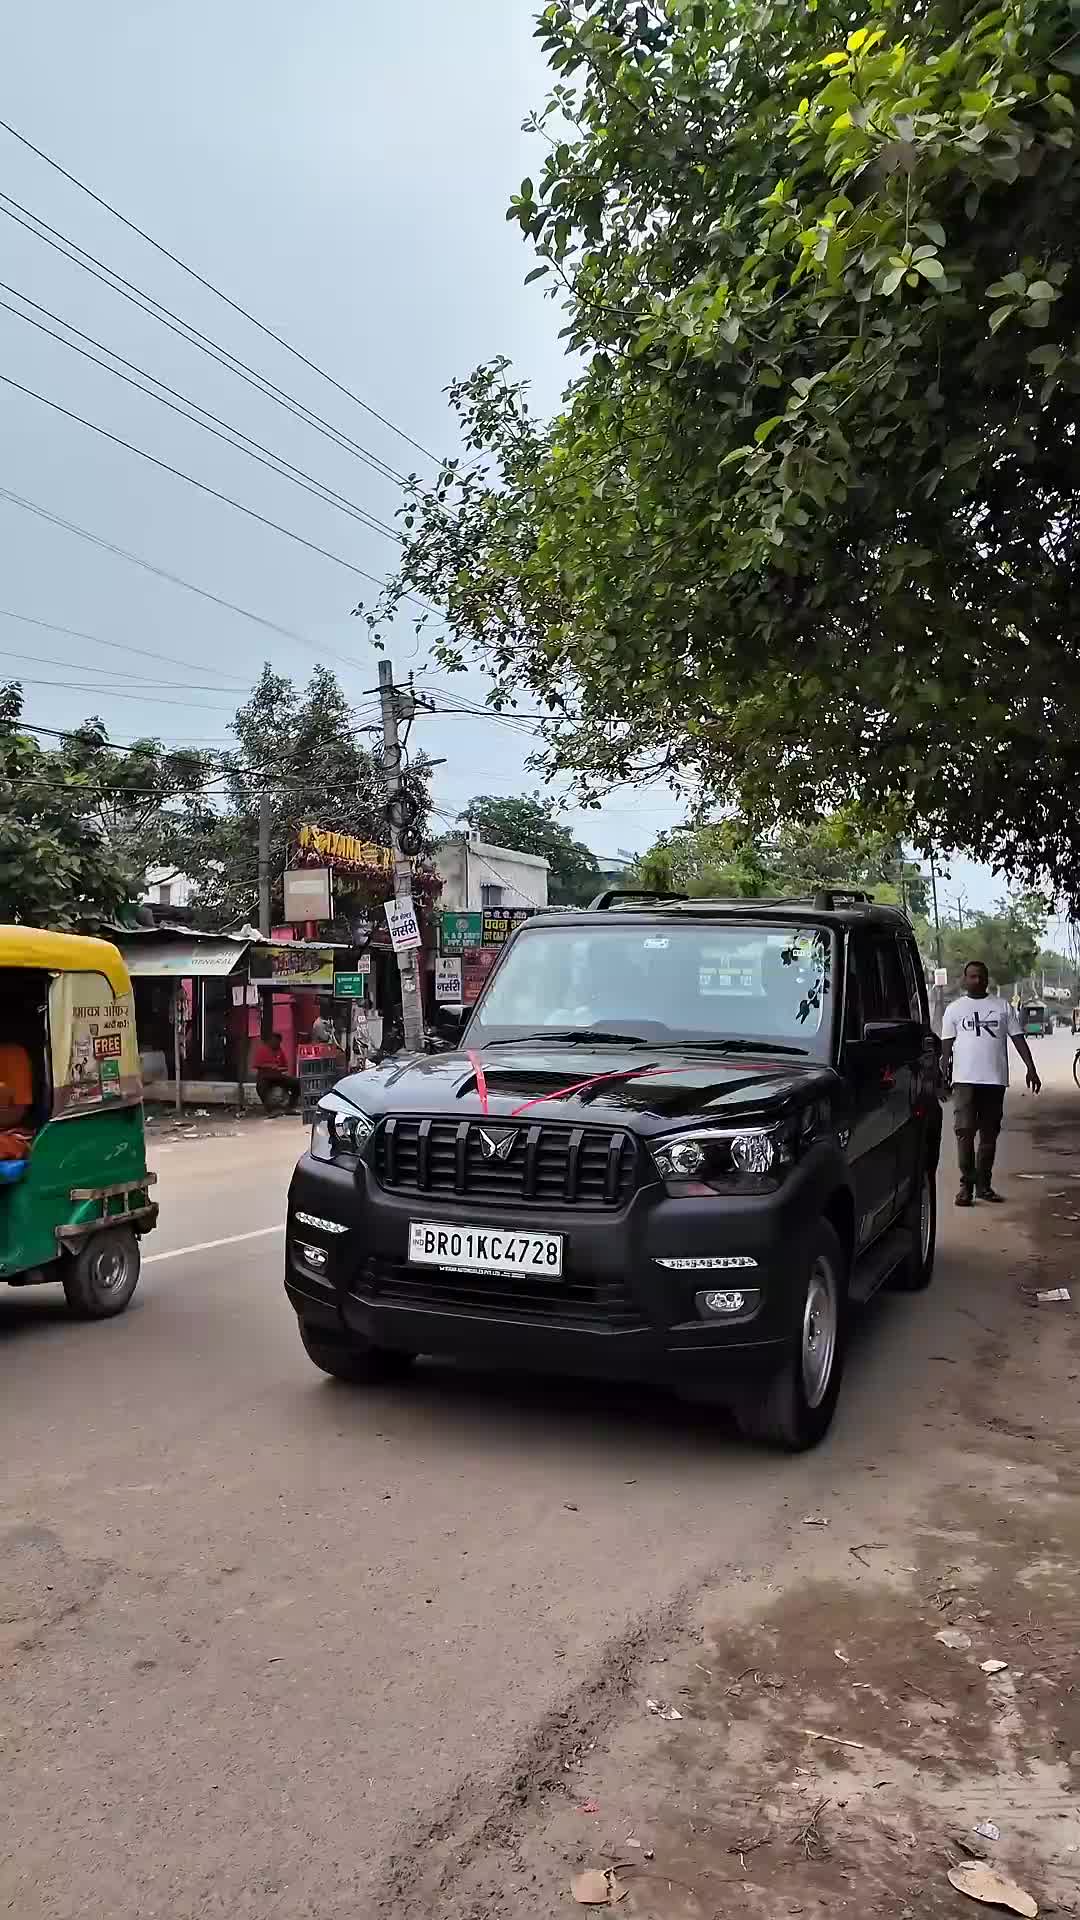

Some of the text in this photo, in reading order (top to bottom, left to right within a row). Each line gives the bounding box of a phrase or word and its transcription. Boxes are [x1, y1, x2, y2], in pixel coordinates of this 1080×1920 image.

[391, 919, 417, 937] नर्सरी
[437, 979, 460, 992] नर्सरी
[95, 1037, 120, 1054] FREE
[424, 1230, 558, 1266] BR01KC4728
